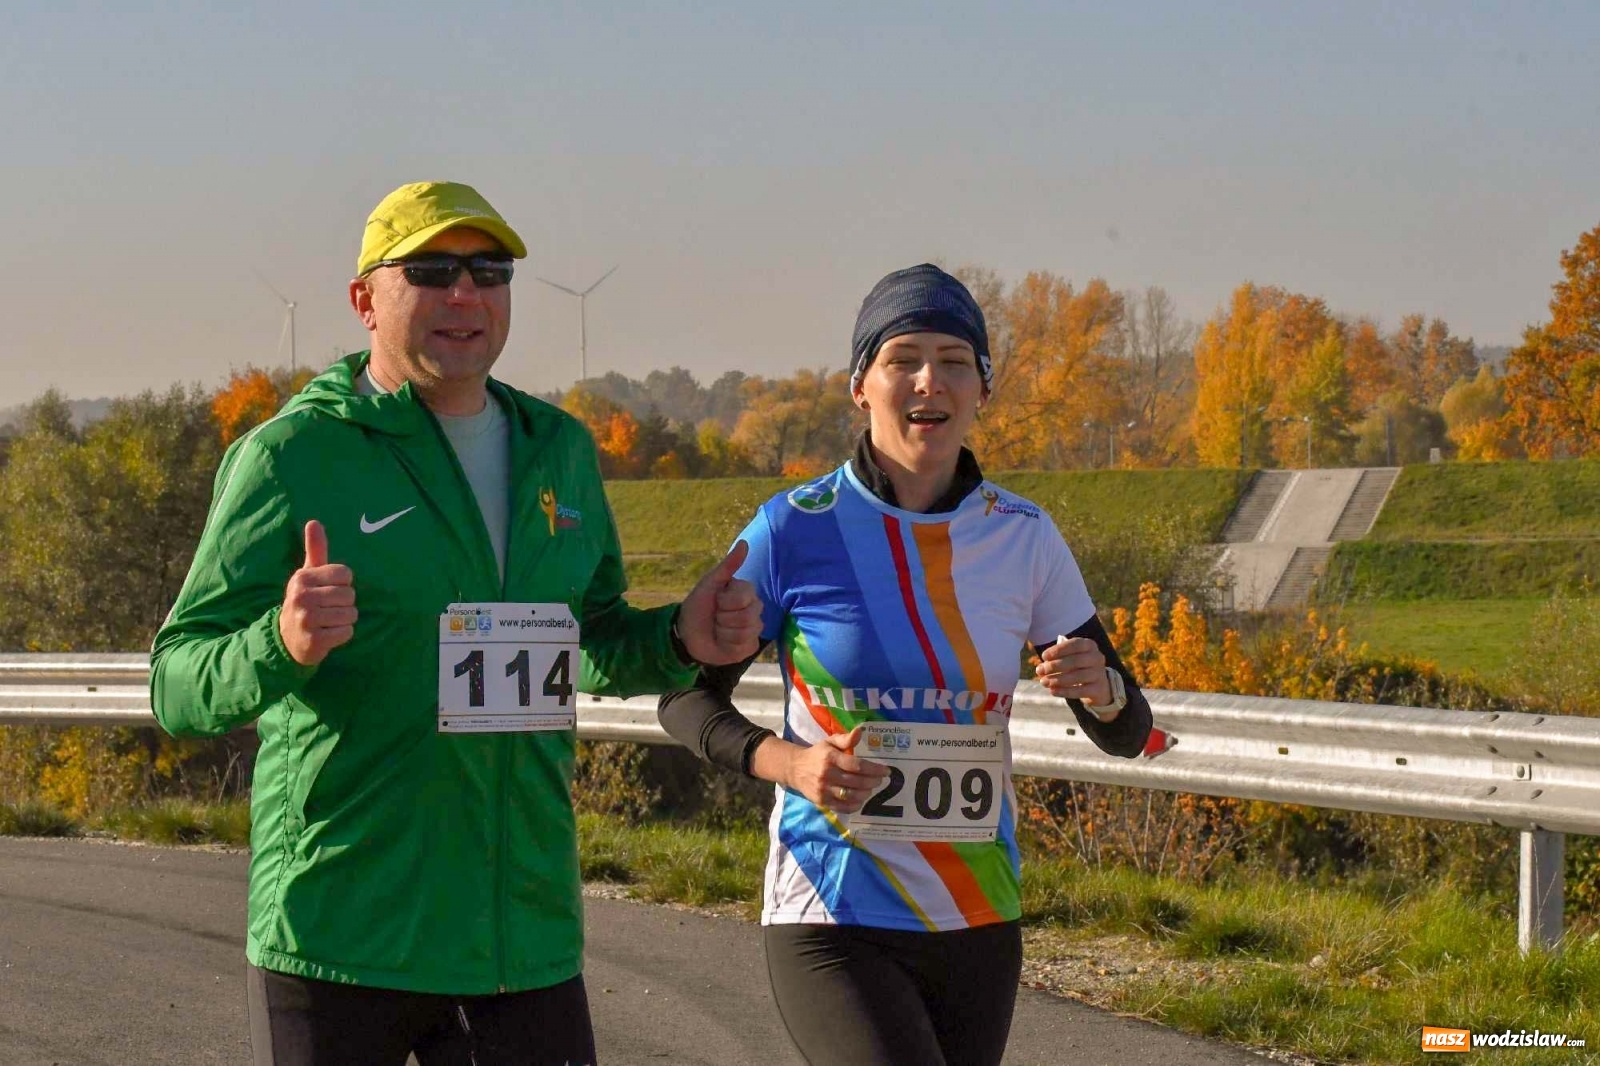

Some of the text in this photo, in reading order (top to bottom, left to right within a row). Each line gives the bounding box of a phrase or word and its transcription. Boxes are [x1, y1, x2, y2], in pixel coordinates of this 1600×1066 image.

[499, 617, 575, 631] www.personalbest.pl
[453, 650, 573, 707] 114
[917, 738, 997, 749] www.personalbest.pl
[861, 765, 993, 820] 209
